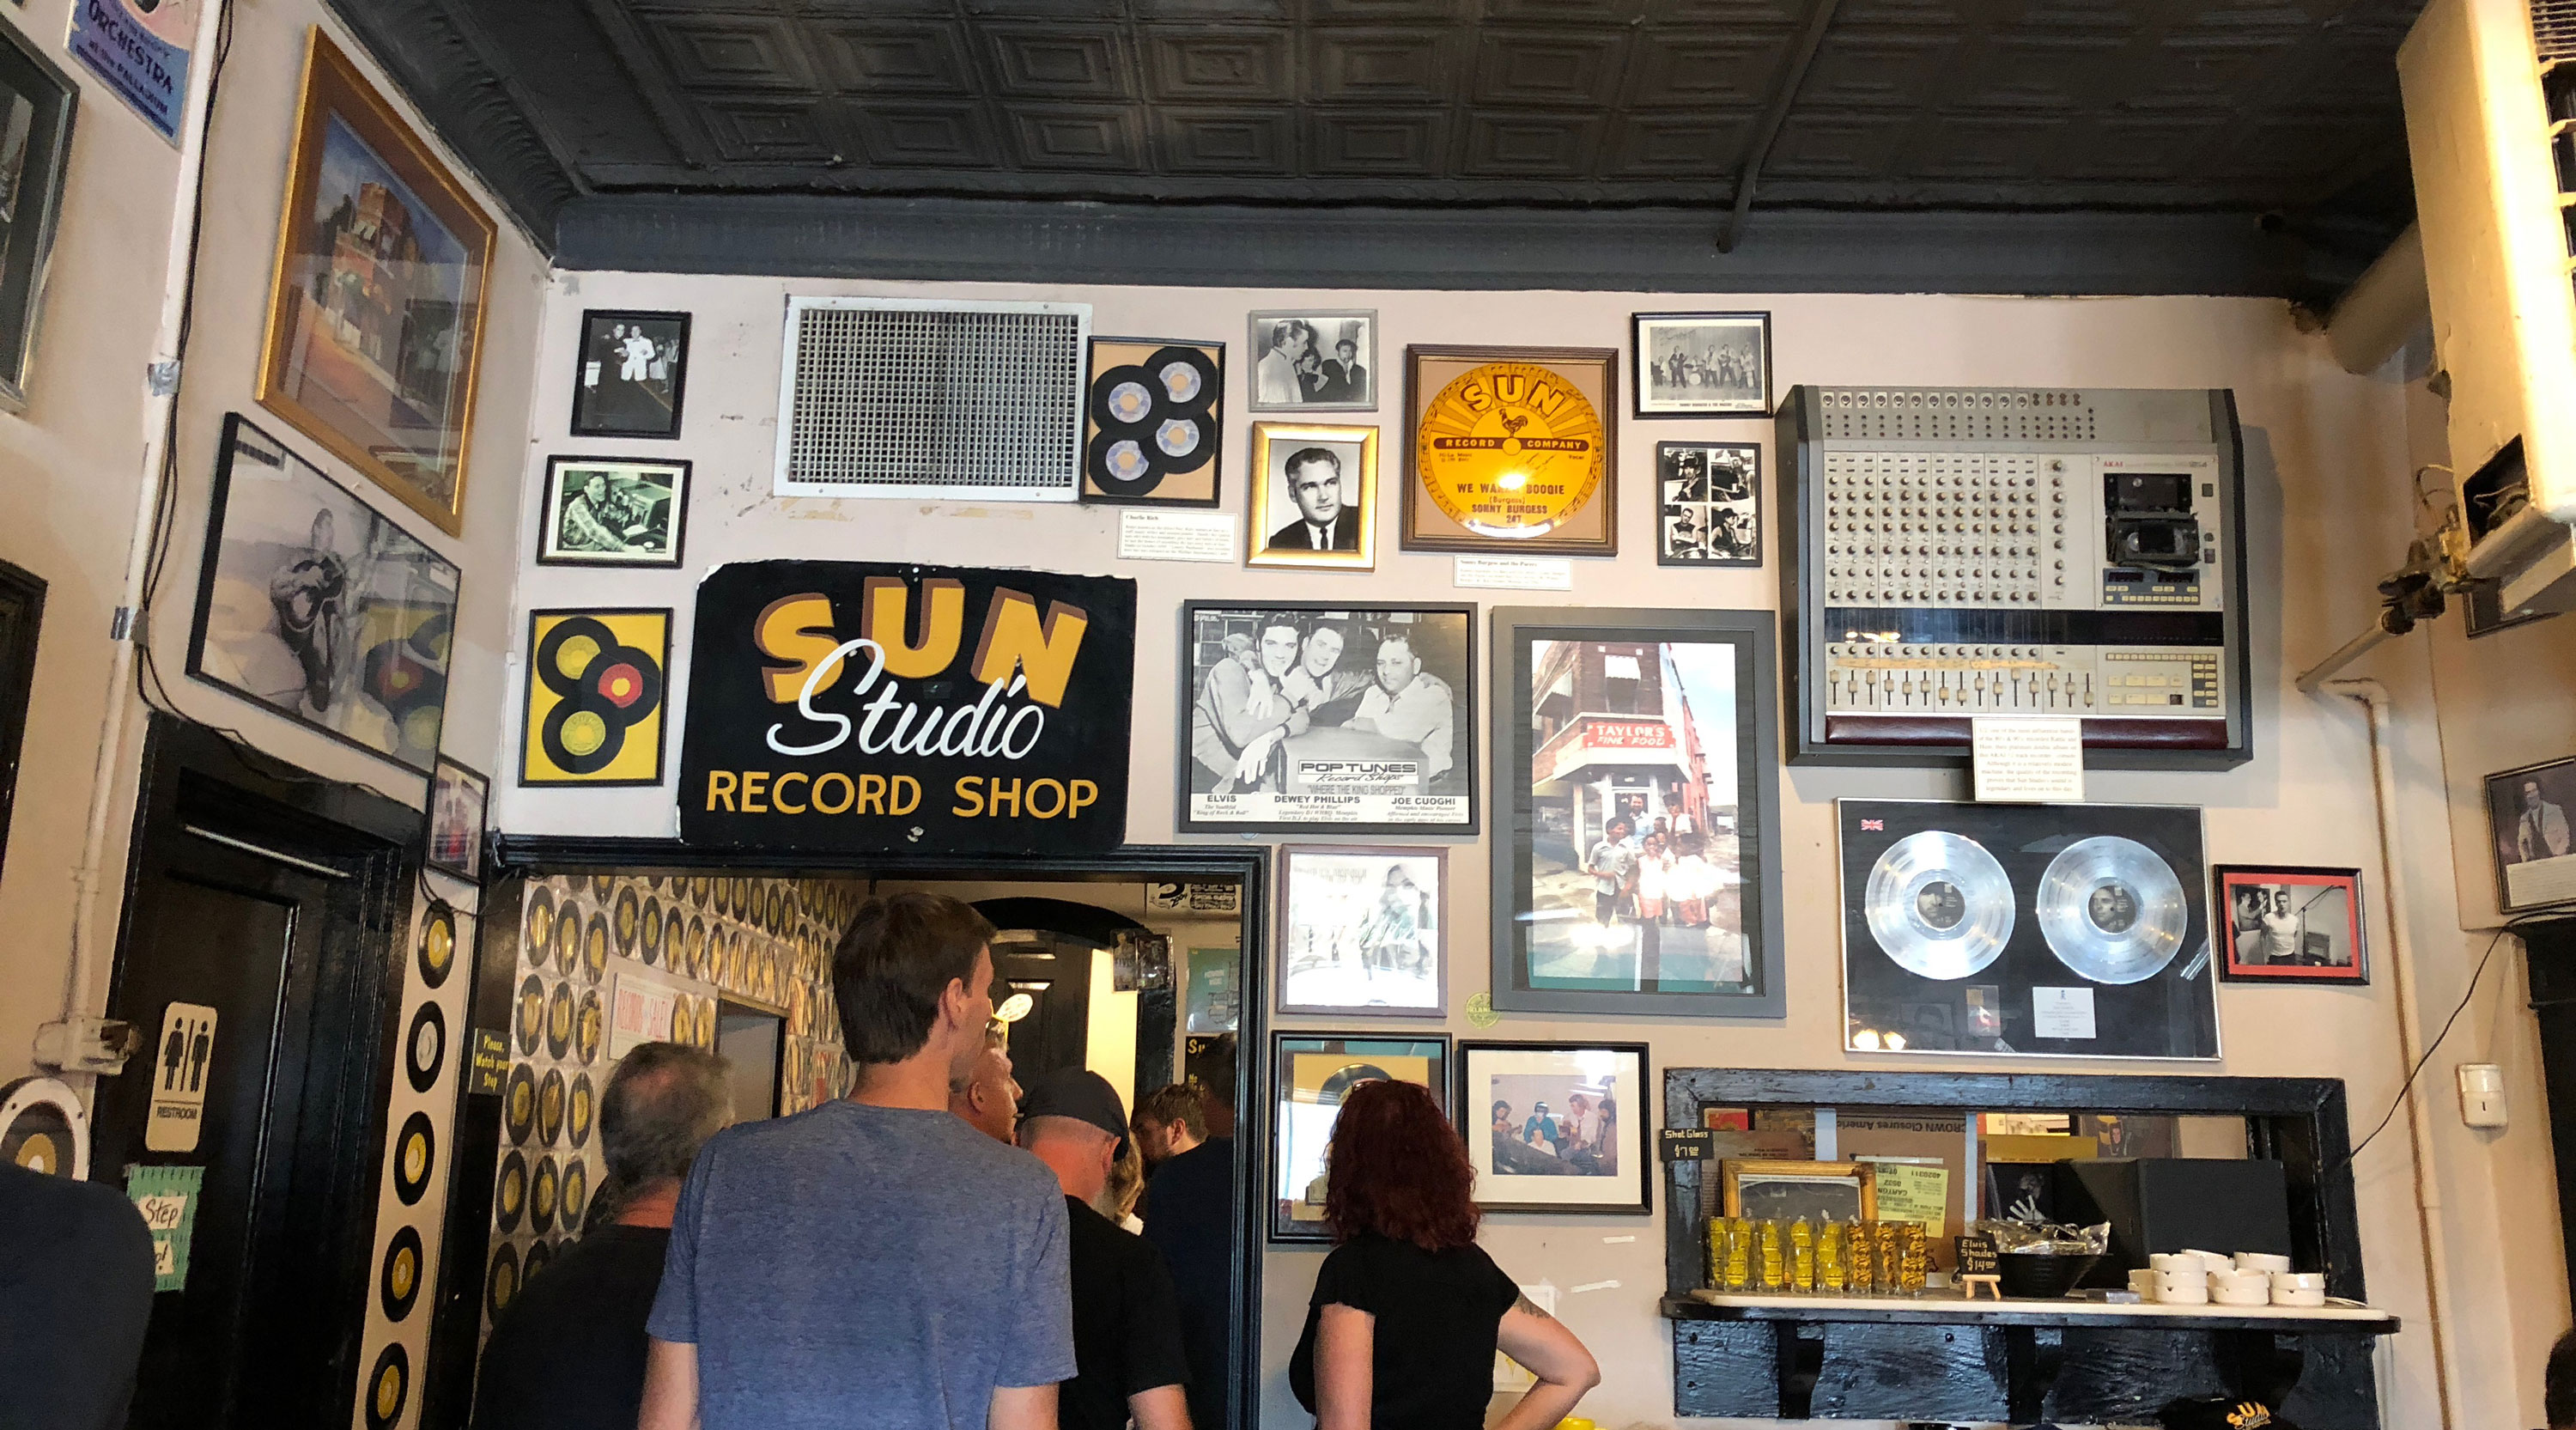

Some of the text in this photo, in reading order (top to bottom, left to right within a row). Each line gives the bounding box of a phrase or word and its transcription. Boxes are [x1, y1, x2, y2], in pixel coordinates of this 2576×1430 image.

[1461, 374, 1565, 417] SUN
[1446, 439, 1582, 449] RECORD COMPANY
[1457, 484, 1473, 493] WE
[1526, 485, 1564, 495] BOOGIE
[1472, 504, 1547, 514] SONNY BURGESS
[1506, 514, 1522, 524] 247
[754, 576, 1088, 709] SUN
[766, 638, 1045, 759] Studio
[1597, 725, 1665, 737] TAYLOR'S
[1597, 736, 1666, 746] FINE FOOD
[1301, 763, 1417, 773] POP TUNES
[1315, 771, 1404, 784] Record Shops
[706, 770, 1099, 819] RECORD SHOP
[1352, 785, 1370, 795] KING
[1314, 795, 1361, 804] PHILLIPS
[1414, 797, 1456, 806] CUOGHI
[156, 1106, 197, 1120] RESTROOM
[1877, 1122, 1923, 1132] Closures
[1665, 1129, 1709, 1139] Shot Glass
[144, 1197, 179, 1223] Step
[1960, 1248, 1998, 1258] Shades
[2226, 1401, 2271, 1426] SUN
